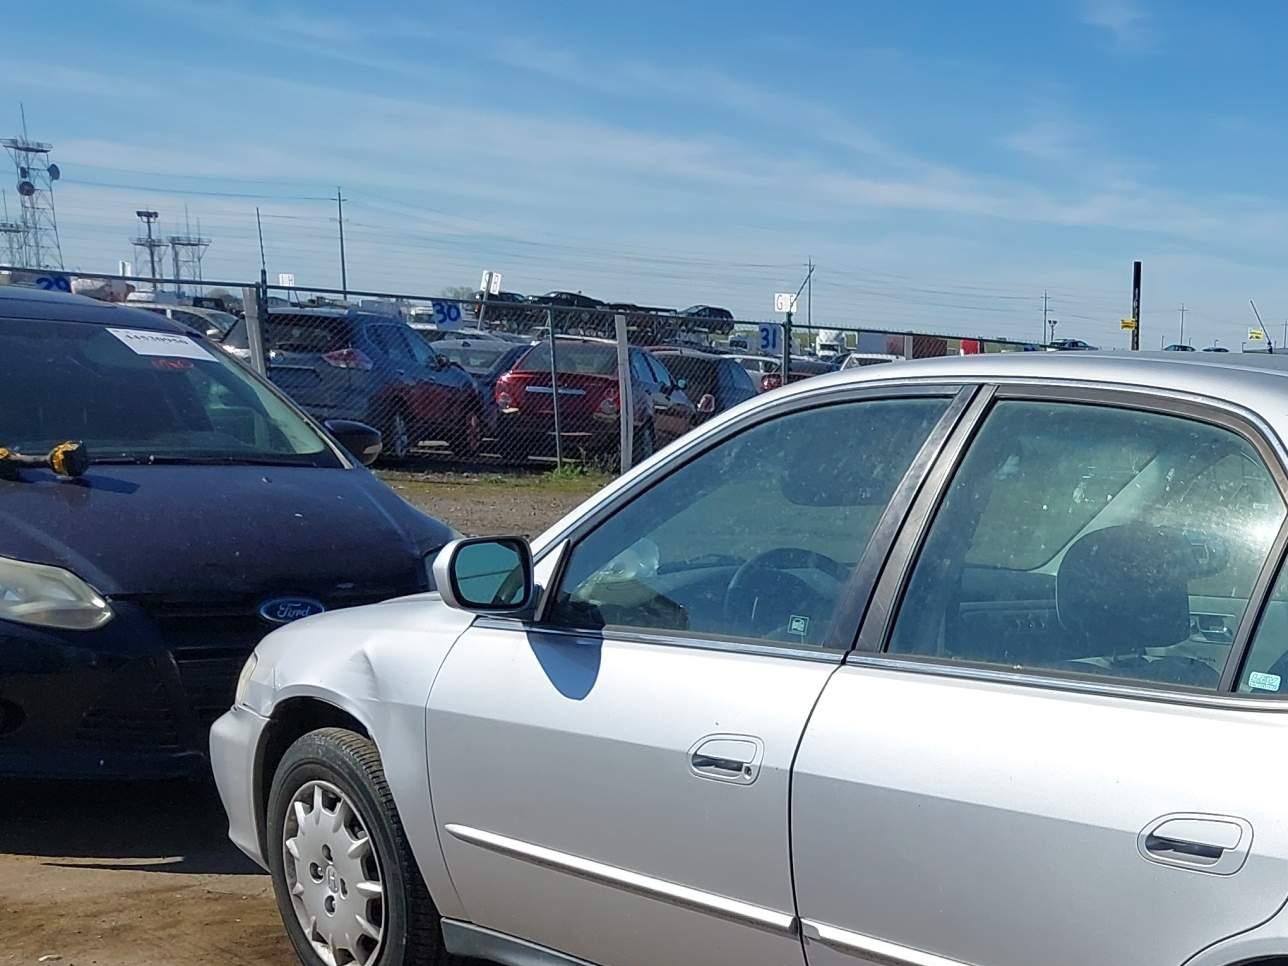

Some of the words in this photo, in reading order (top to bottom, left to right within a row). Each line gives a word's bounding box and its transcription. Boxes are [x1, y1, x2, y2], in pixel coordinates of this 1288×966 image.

[433, 302, 460, 323] 30
[761, 327, 777, 349] 31
[277, 603, 311, 618] Ford
